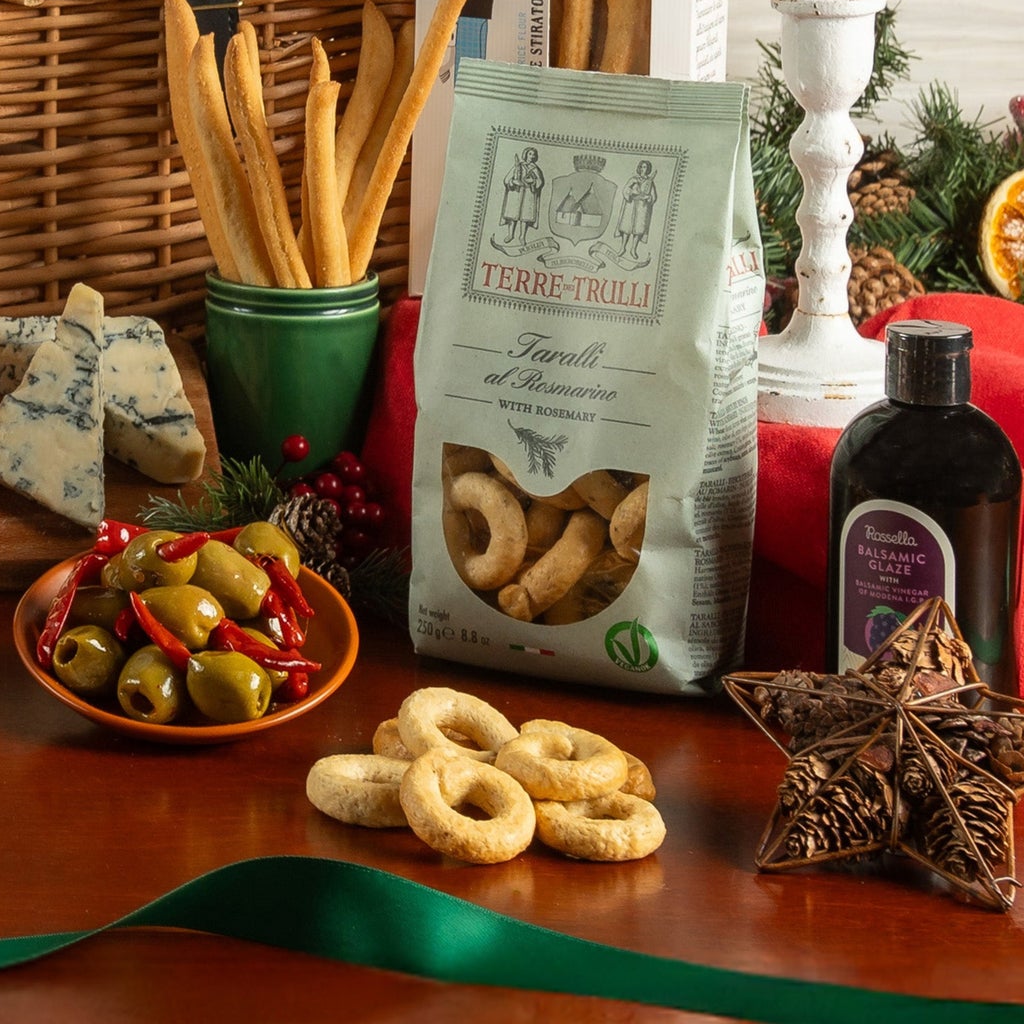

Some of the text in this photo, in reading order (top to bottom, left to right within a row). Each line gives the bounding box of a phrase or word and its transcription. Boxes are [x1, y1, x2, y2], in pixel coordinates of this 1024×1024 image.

[518, 12, 526, 40] FLOUR
[482, 262, 564, 300] TERRE
[573, 276, 651, 308] TRULLI
[507, 332, 607, 370] Taralli
[484, 366, 618, 402] al Rosmarino
[498, 398, 597, 422] WITH ROSEMARY
[864, 524, 918, 546] Rossella
[858, 544, 926, 564] BALSAMIC
[868, 560, 912, 576] GLAZE
[856, 580, 928, 596] BALSAMIC VINEGAR
[880, 576, 899, 584] WITH
[870, 591, 903, 602] MODENA
[417, 619, 433, 636] 250
[461, 628, 478, 644] 8.8
